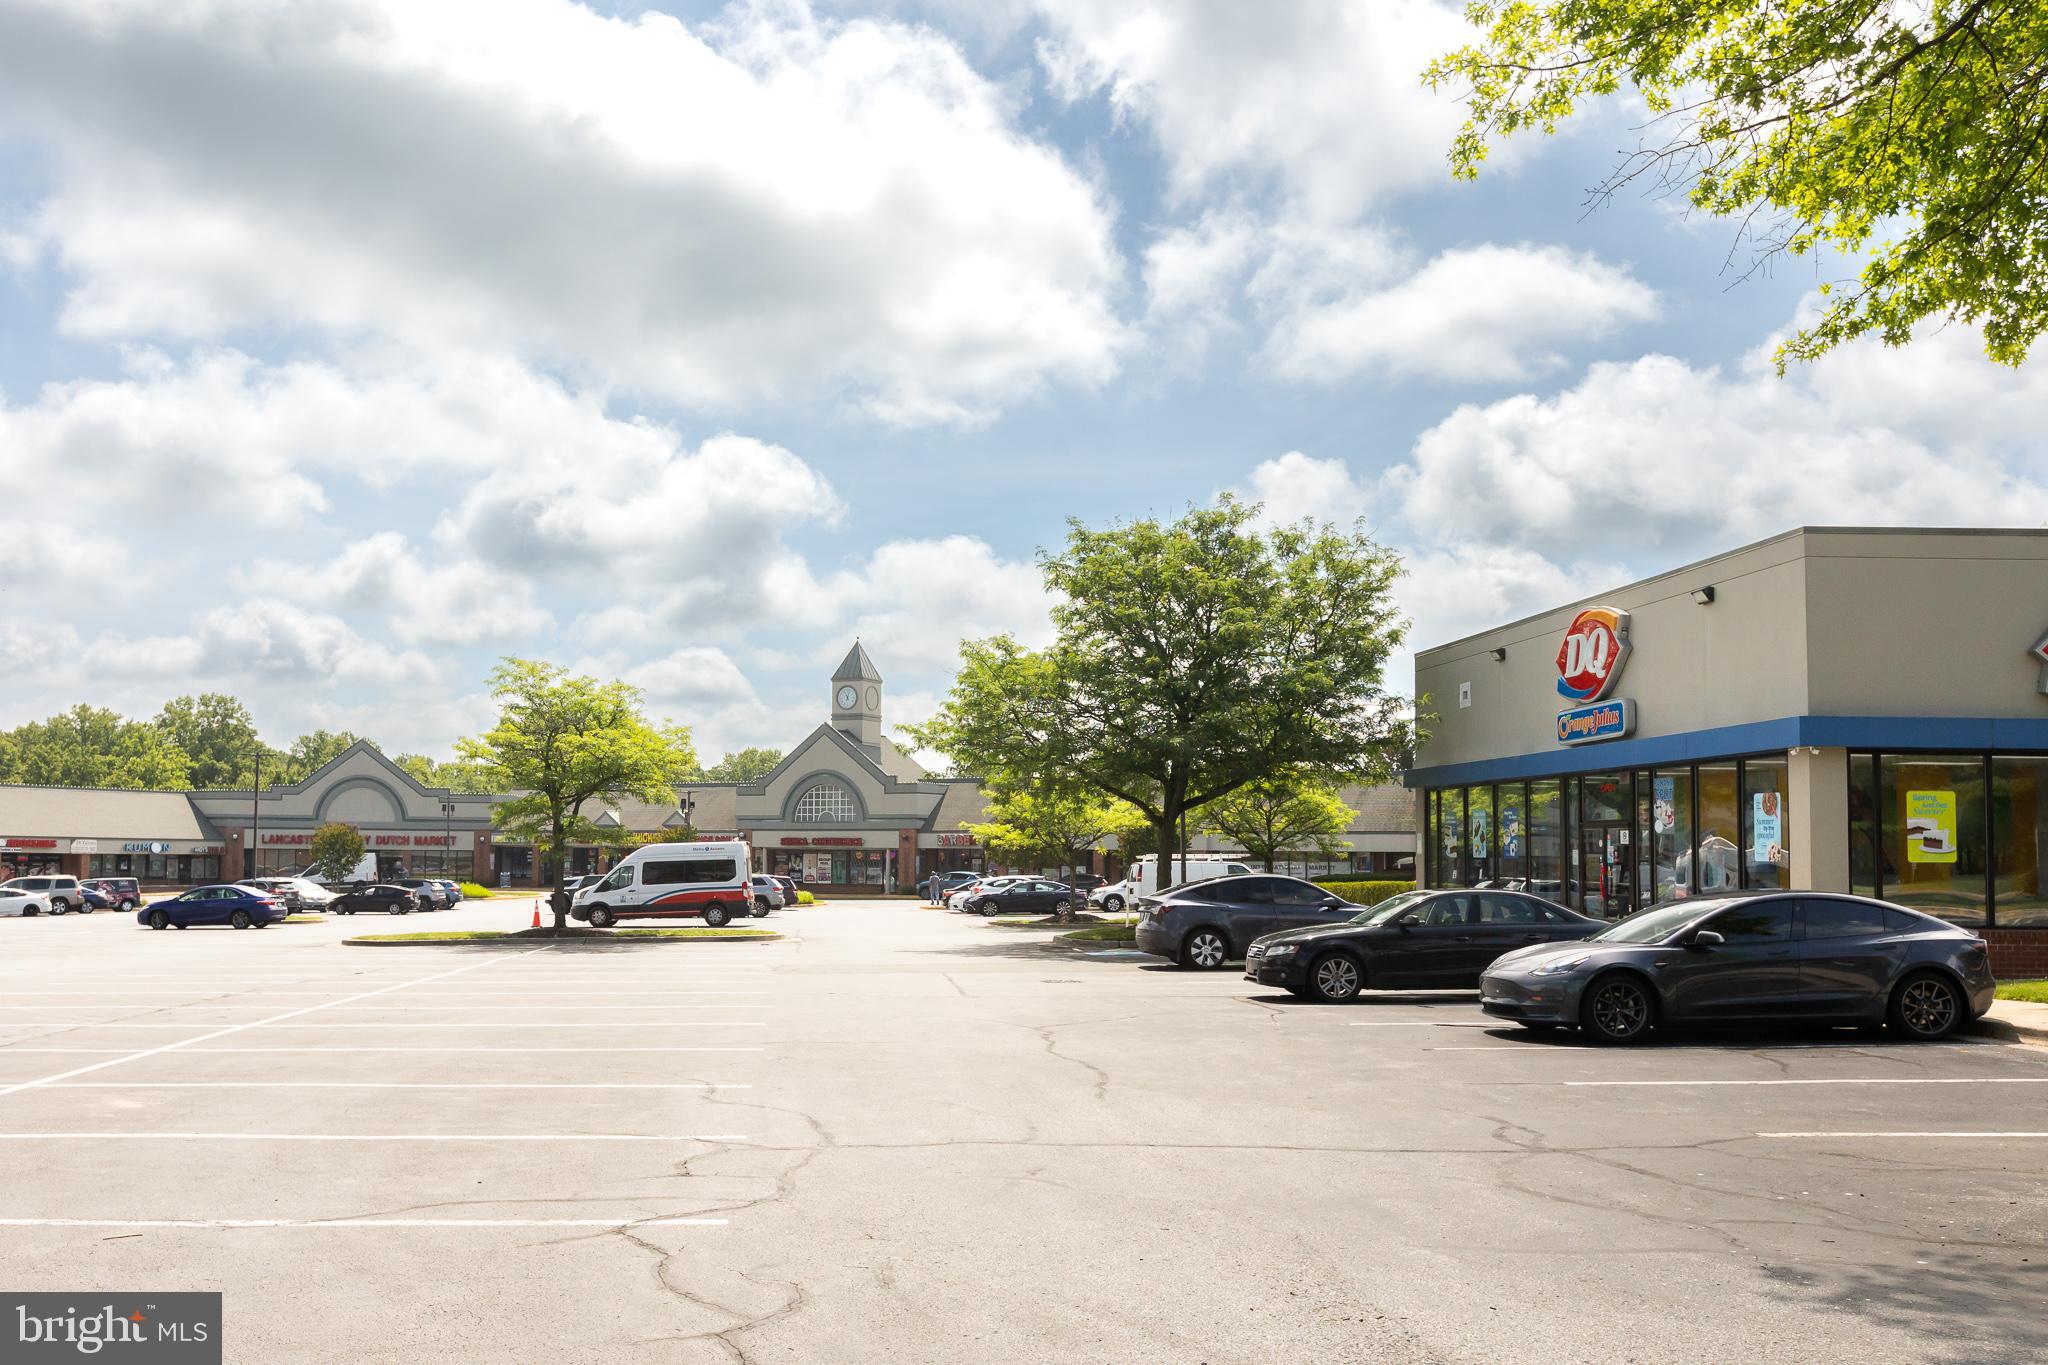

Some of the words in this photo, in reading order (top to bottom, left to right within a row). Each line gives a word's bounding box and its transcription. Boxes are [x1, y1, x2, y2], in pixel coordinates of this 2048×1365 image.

[1565, 627, 1609, 679] DQ
[1559, 715, 1594, 739] Orange
[1592, 707, 1620, 734] Julius
[124, 842, 171, 854] KUMON
[261, 834, 315, 845] LANCAST
[375, 835, 410, 846] DUTCH
[414, 835, 457, 846] MARKET
